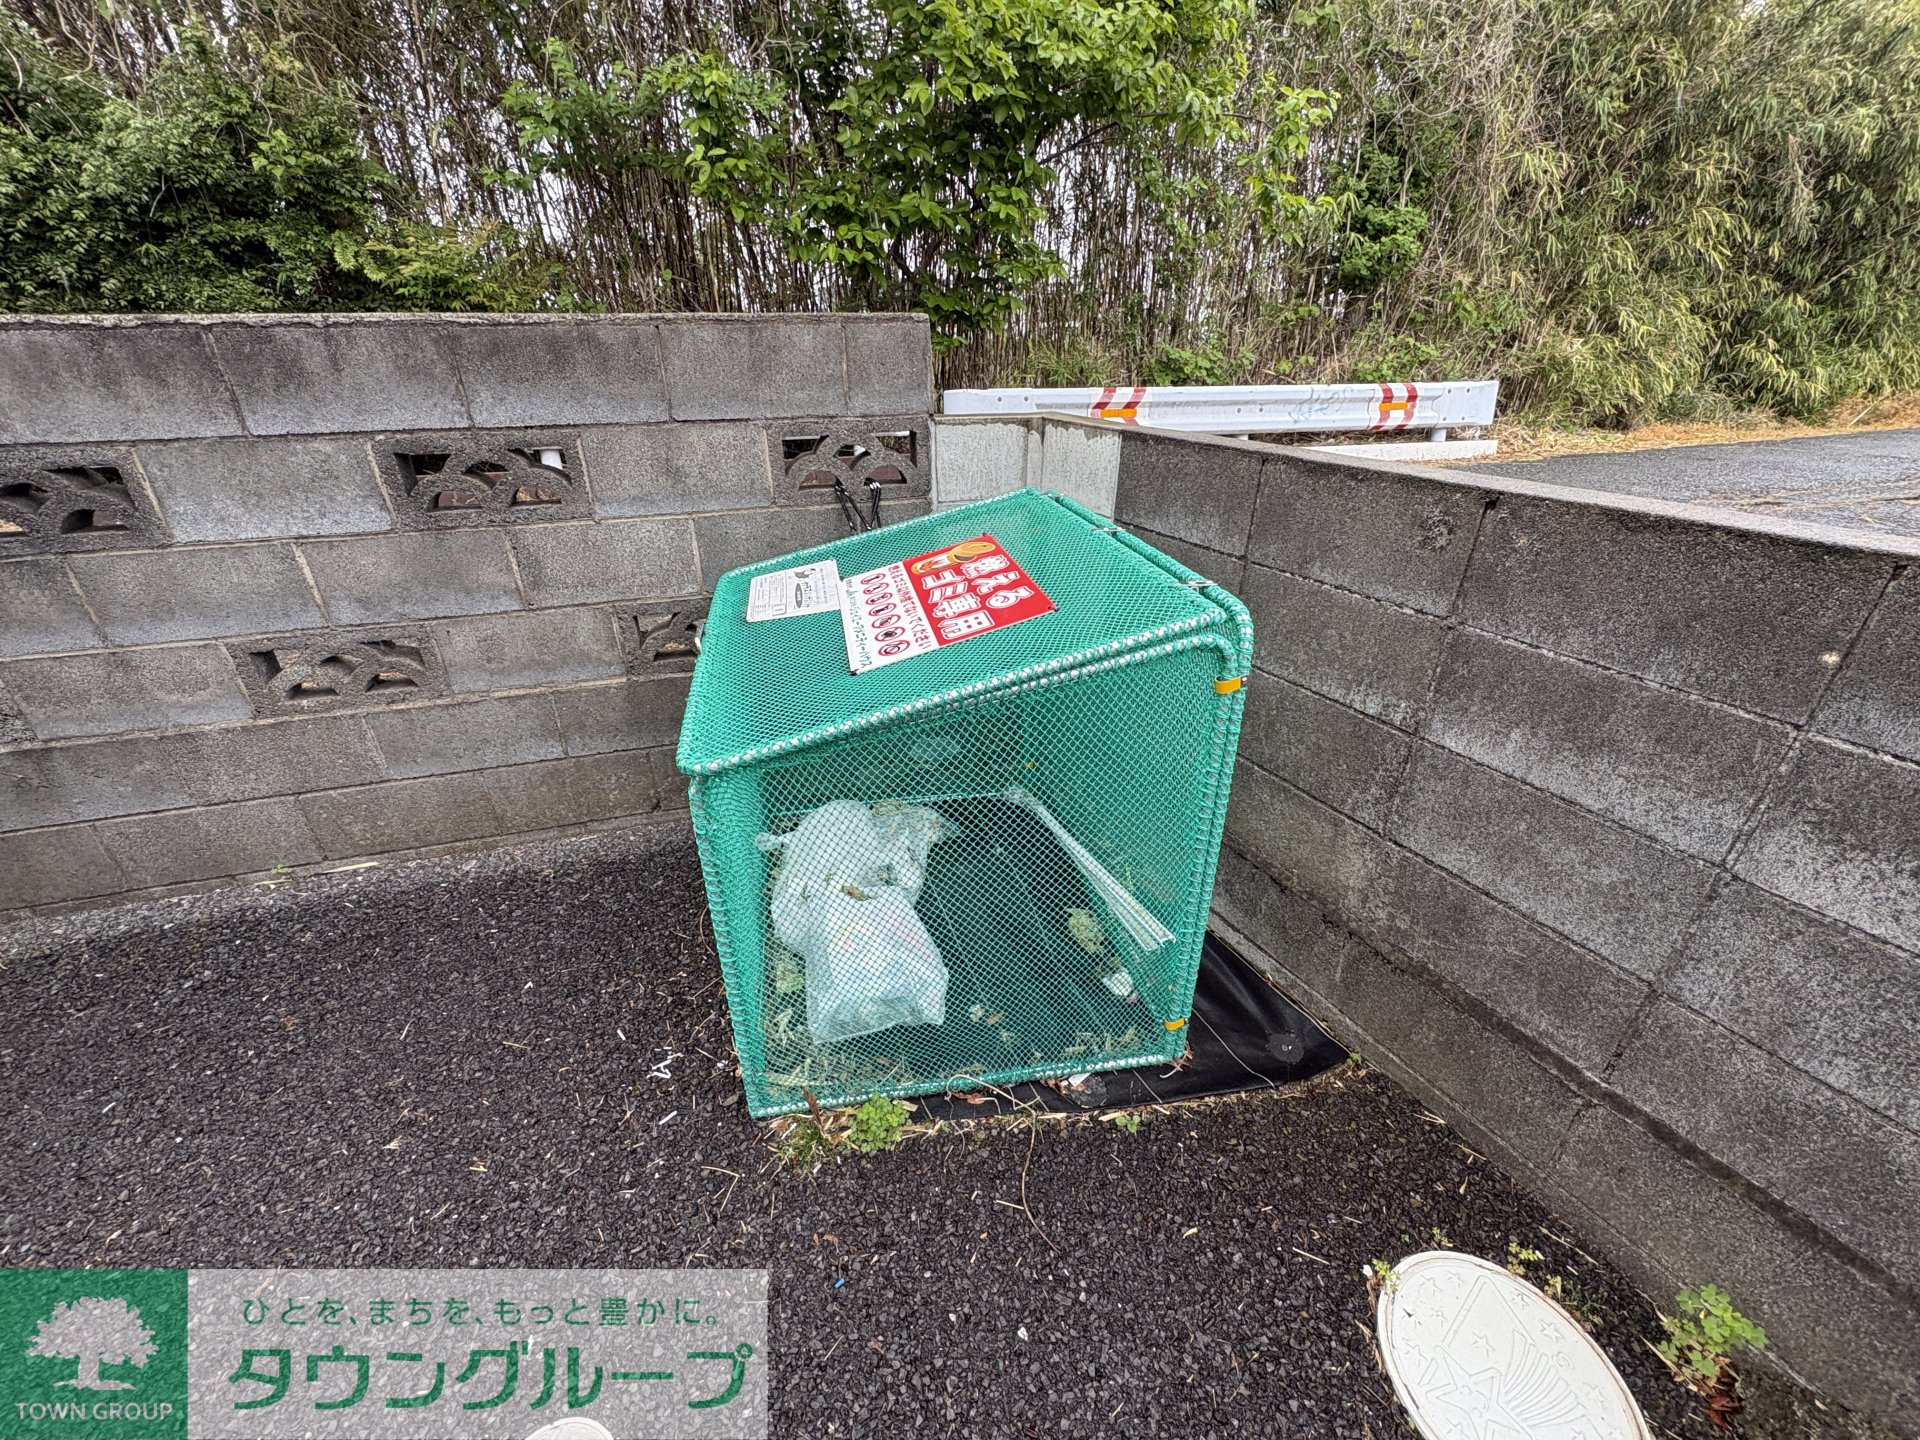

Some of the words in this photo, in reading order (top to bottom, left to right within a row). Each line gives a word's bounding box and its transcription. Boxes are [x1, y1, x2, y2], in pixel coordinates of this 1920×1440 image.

[921, 569, 995, 640] ゴミ専用
[960, 554, 1035, 609] 燃える
